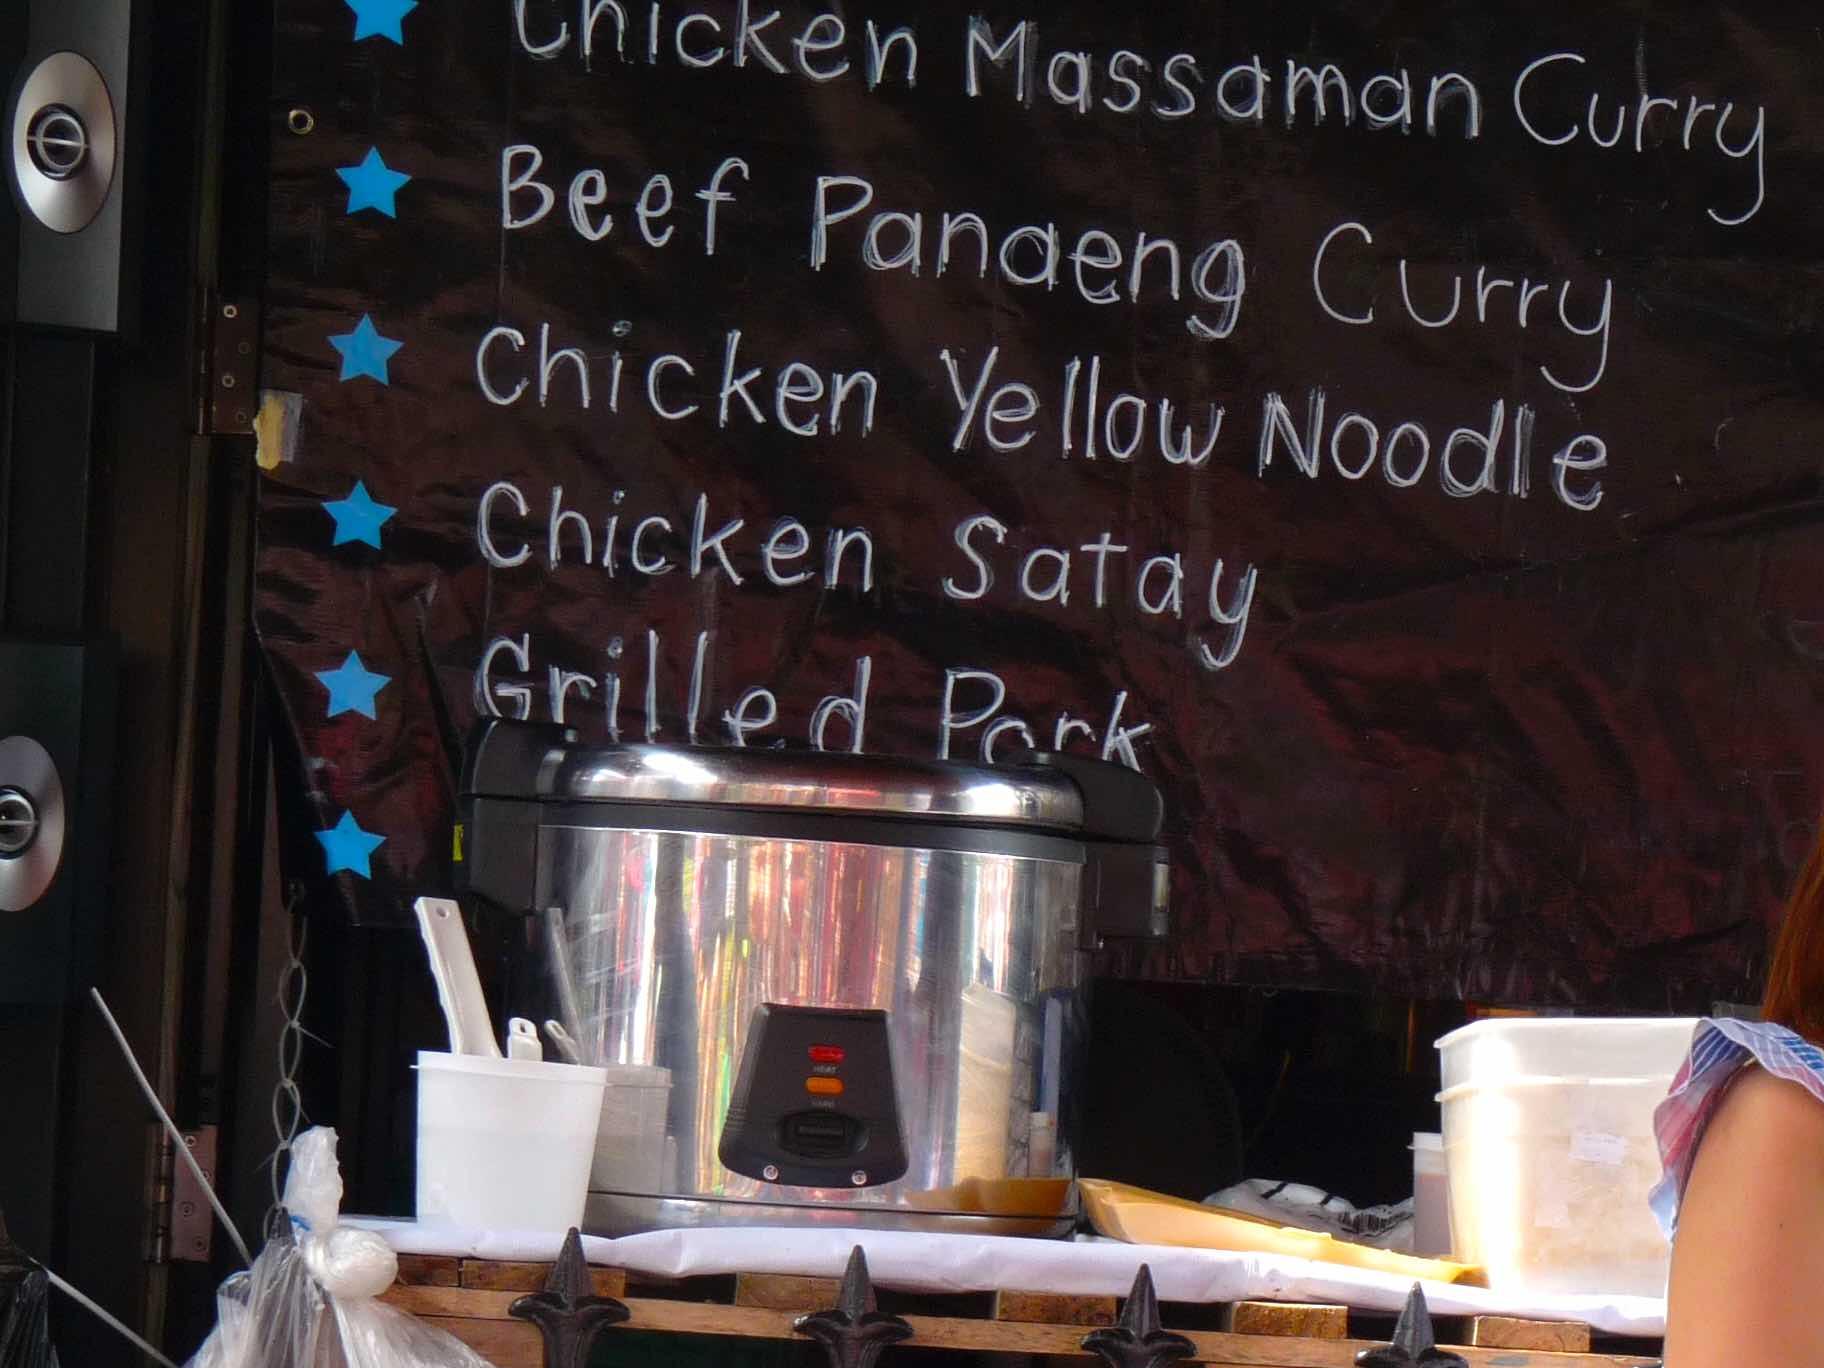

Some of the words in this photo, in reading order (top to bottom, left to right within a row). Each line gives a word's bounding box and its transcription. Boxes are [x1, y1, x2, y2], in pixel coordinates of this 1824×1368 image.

[515, 0, 920, 92] Chicken
[966, 12, 1481, 141] Massaman
[1513, 53, 1765, 226] Curry
[501, 144, 750, 256] Beef
[811, 175, 1246, 339] Panaeng
[1313, 222, 1613, 392] Curry
[476, 320, 878, 436] Chicken
[939, 347, 1225, 463] Yellow
[1258, 386, 1609, 512] Noodle
[477, 480, 874, 592] Chicken
[942, 514, 1258, 671] Satay
[472, 630, 874, 752] Grilled
